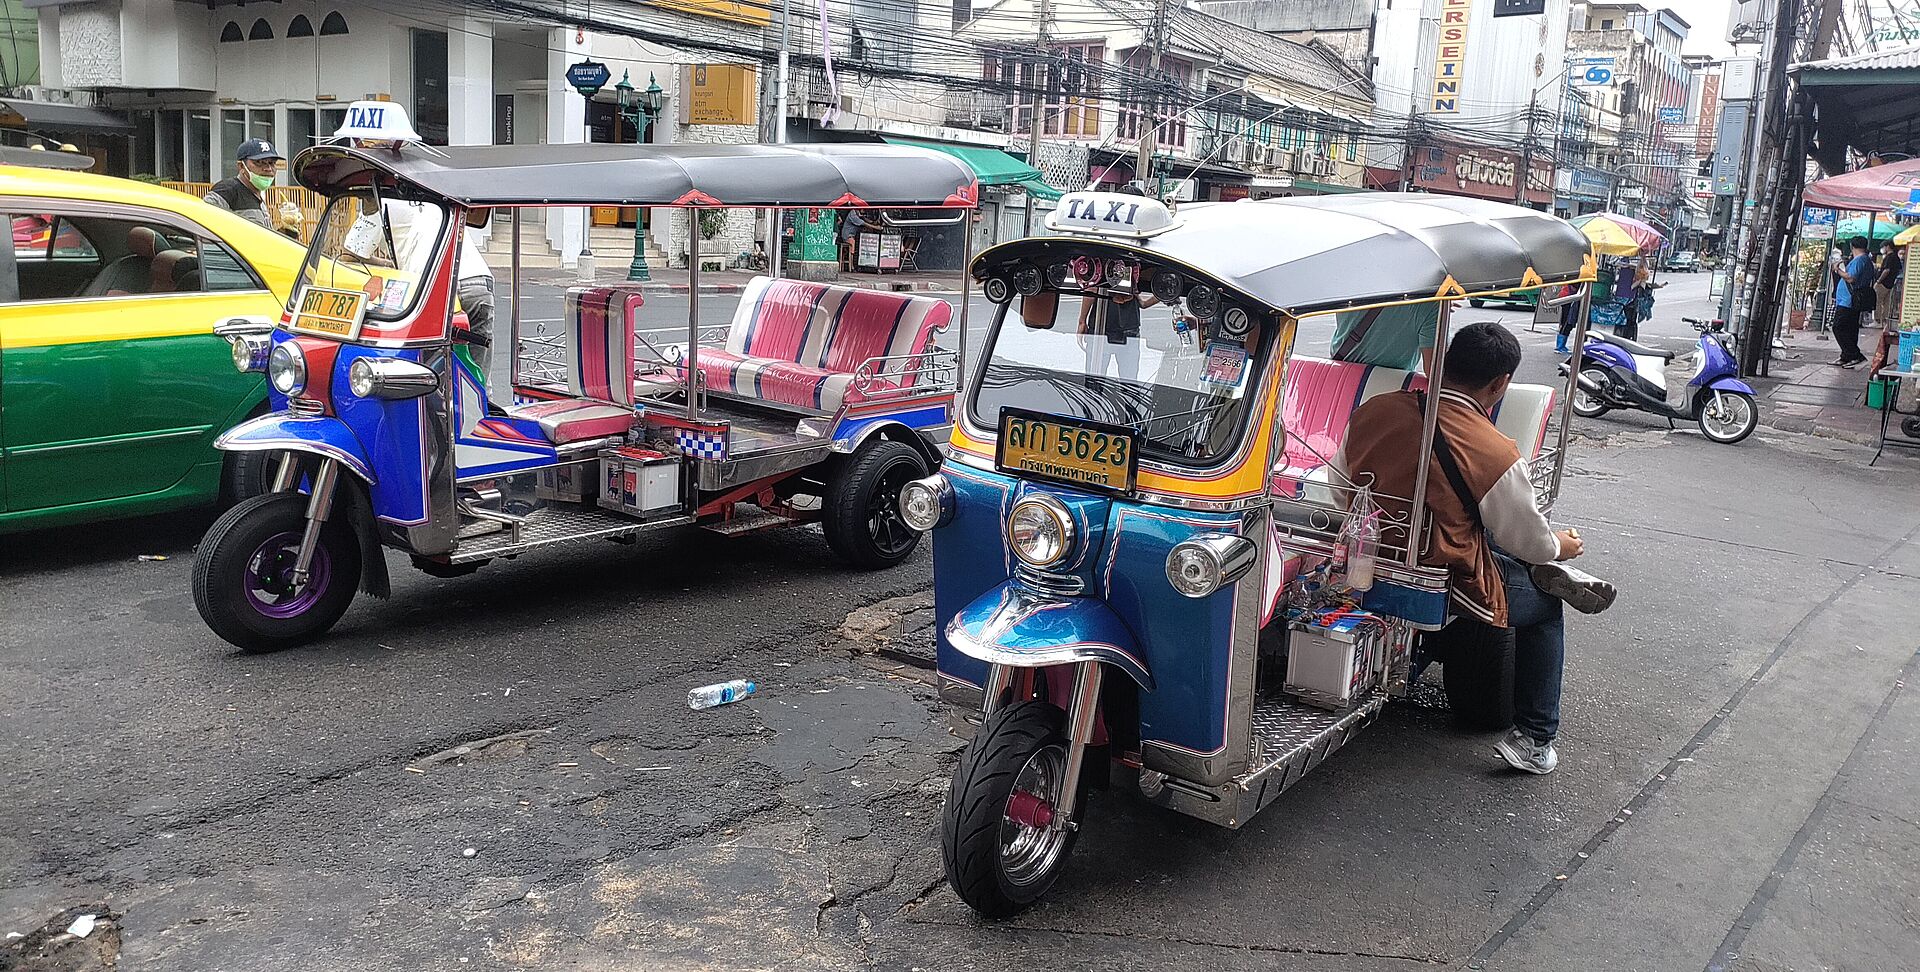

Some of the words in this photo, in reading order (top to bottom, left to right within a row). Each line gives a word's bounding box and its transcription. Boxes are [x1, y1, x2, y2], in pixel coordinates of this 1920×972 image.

[349, 107, 385, 129] TAXI
[505, 105, 513, 143] banking
[694, 108, 724, 117] exchange
[1067, 198, 1140, 225] TAXI
[328, 294, 355, 317] 787
[1222, 357, 1242, 368] 2566
[1009, 419, 1047, 452] สก
[1057, 426, 1127, 466] 5623
